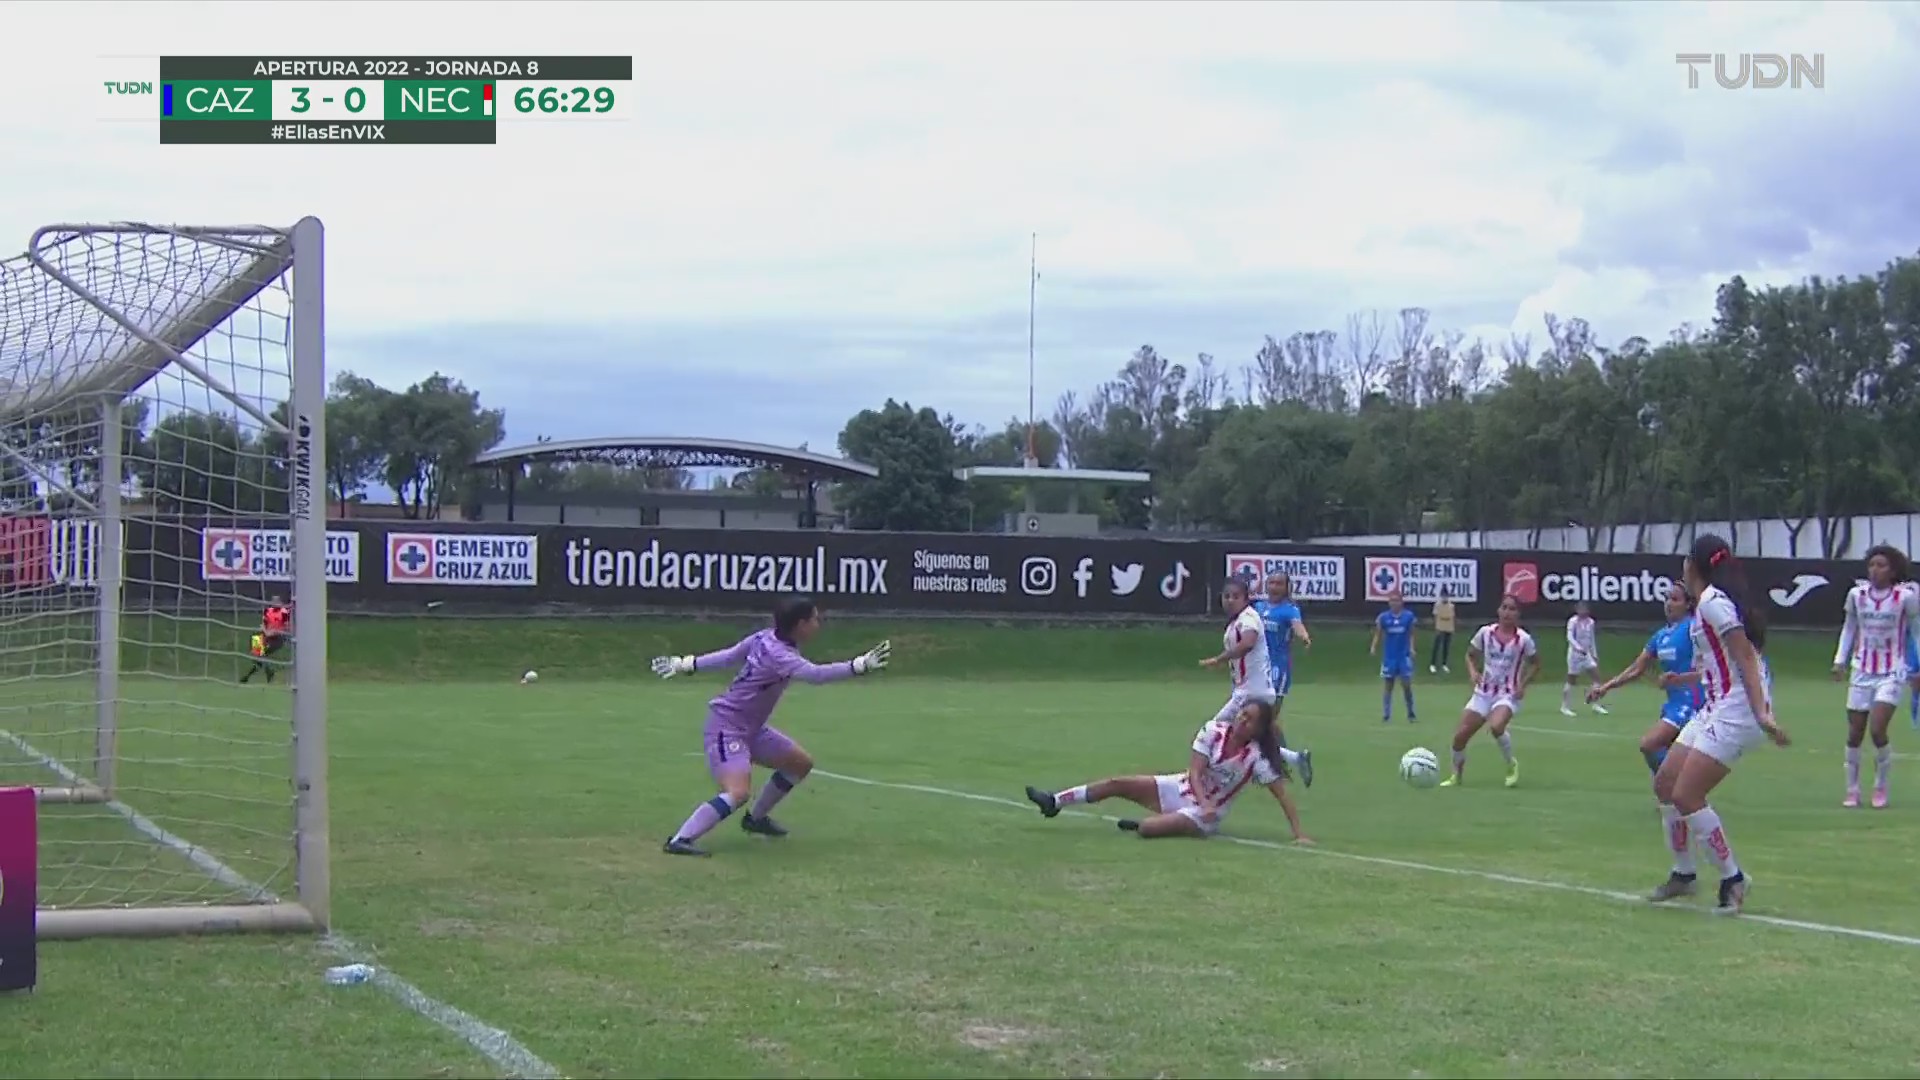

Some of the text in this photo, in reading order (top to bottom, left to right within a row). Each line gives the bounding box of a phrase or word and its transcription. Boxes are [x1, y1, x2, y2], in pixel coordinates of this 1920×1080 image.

[435, 539, 528, 558] CEMENTO
[435, 561, 532, 580] CRUZ AZUL
[566, 537, 888, 594] tiendacruzazul.mx
[913, 549, 990, 573] Síguenos en
[1264, 559, 1337, 576] CEMENTO
[1401, 562, 1470, 579] CEMENTO
[912, 573, 1007, 593] nuestras redes
[1305, 580, 1340, 596] AZUL
[1401, 581, 1436, 597] CRUZ
[1541, 566, 1674, 602] caliente
